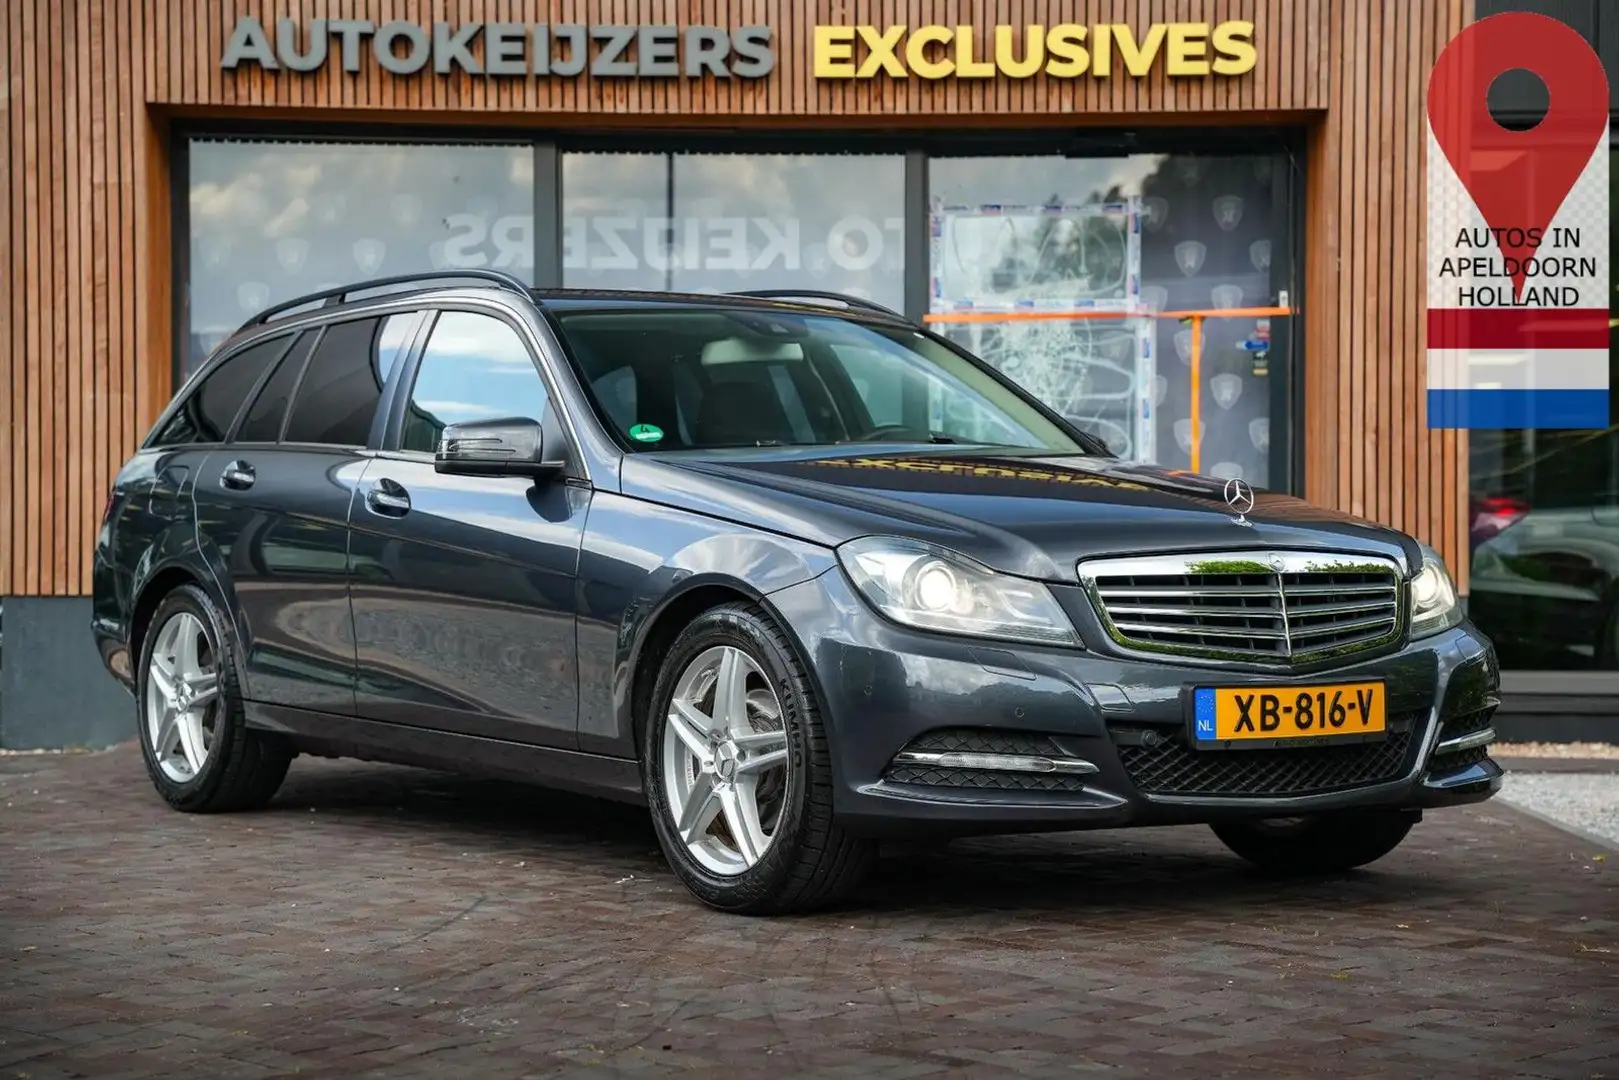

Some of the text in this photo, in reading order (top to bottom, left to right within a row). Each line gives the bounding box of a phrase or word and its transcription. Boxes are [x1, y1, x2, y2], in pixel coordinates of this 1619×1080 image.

[221, 16, 1257, 79] AUTOKEIJZERS EXCLUSIVES
[1198, 720, 1213, 732] NL
[1234, 689, 1373, 732] XB-816-V
